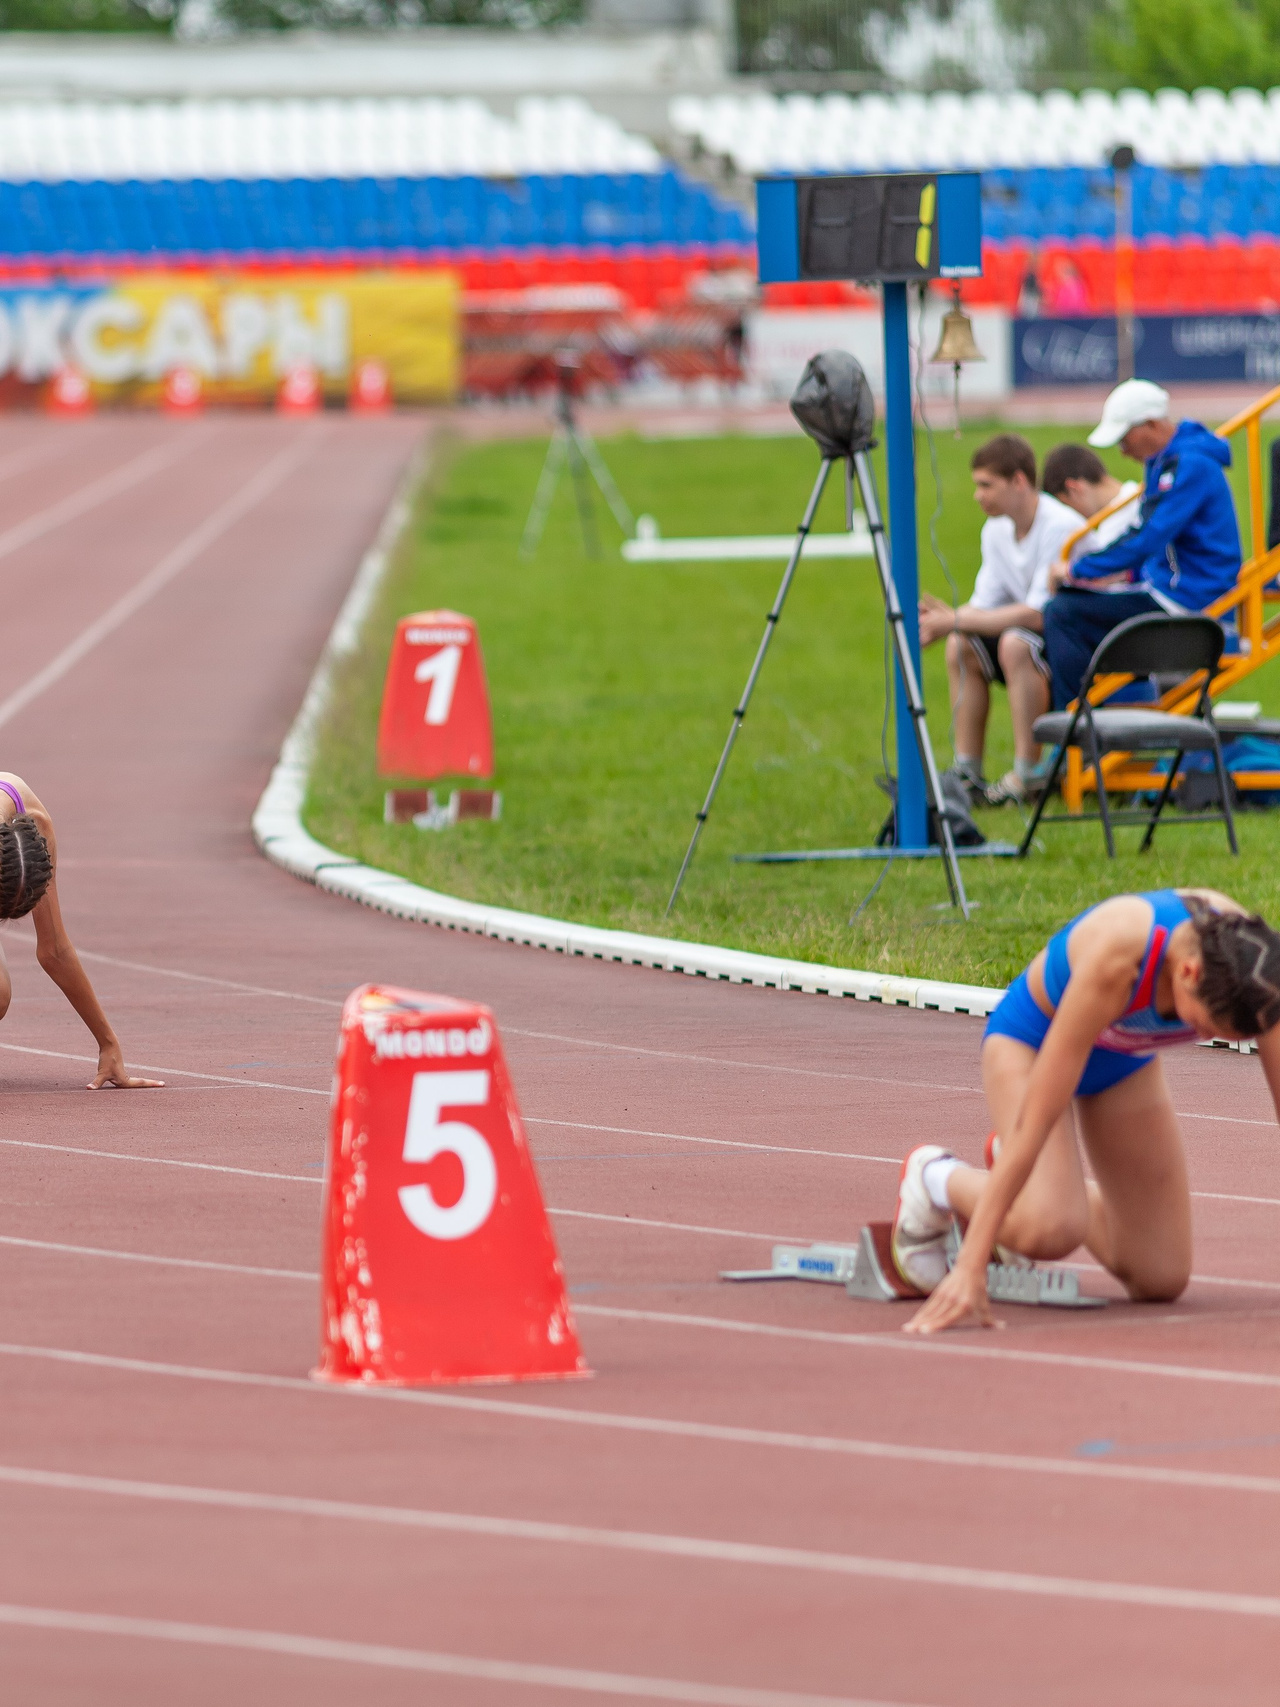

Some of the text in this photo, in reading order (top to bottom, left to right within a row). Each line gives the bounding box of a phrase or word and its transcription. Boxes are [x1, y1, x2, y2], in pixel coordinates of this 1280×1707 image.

[915, 182, 936, 270] 1
[414, 644, 464, 726] 1
[375, 1028, 489, 1060] MONDO
[397, 1069, 499, 1241] 5
